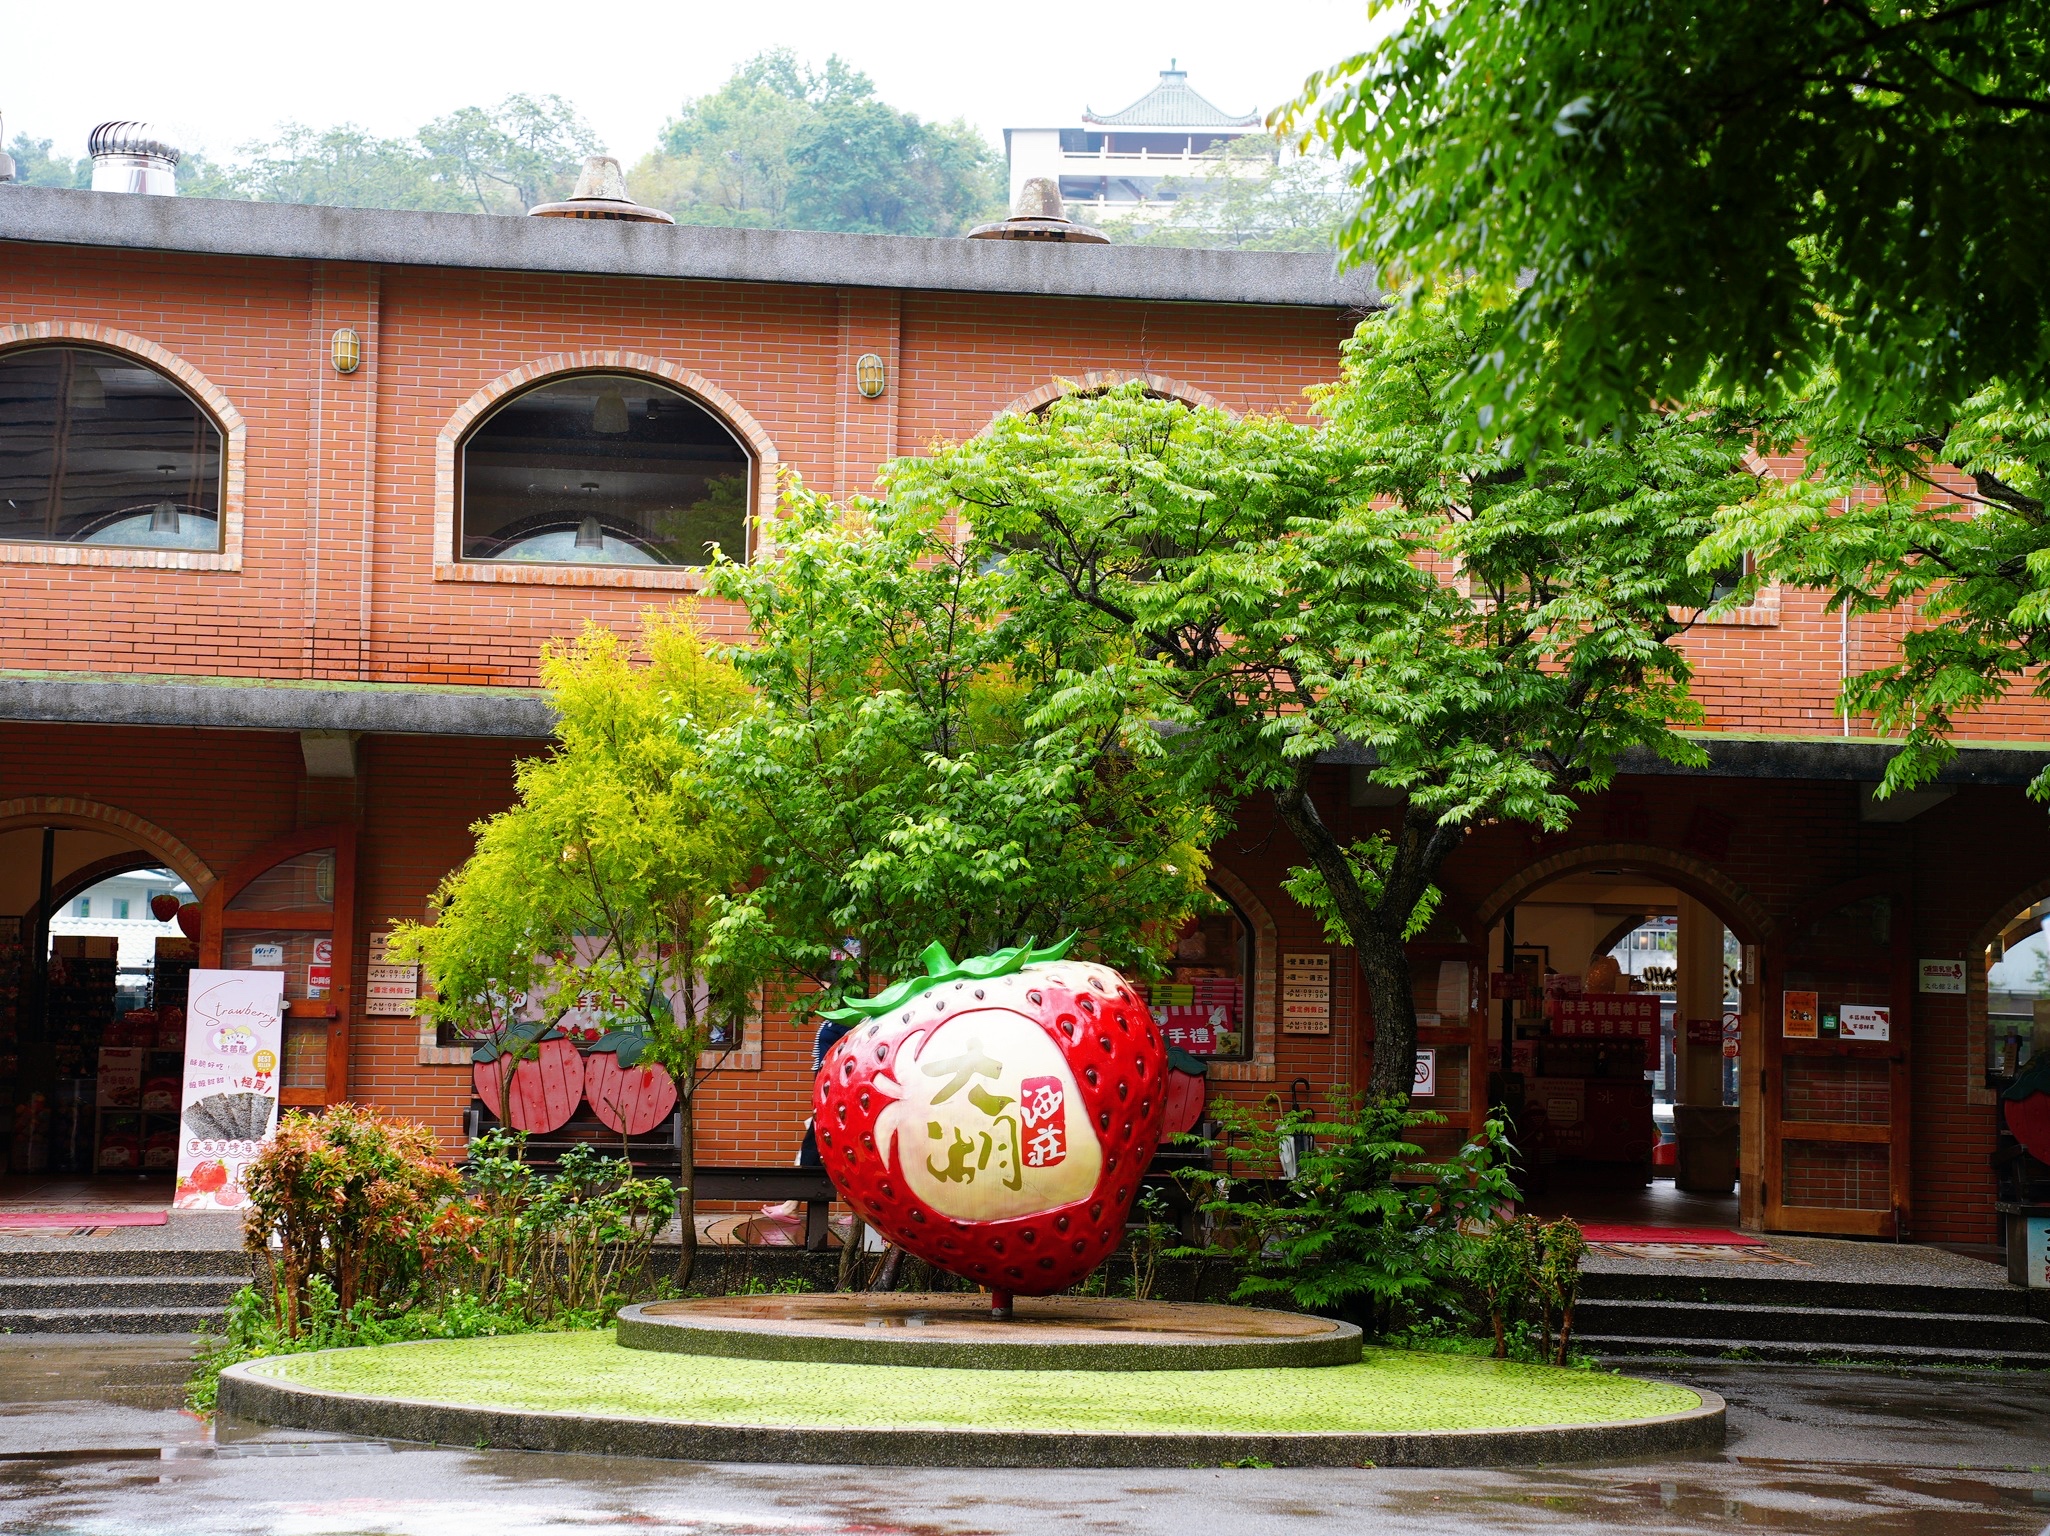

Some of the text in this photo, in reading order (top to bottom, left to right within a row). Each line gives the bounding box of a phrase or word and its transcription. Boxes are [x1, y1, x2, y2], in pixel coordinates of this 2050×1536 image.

[1290, 958, 1324, 966] 營業時間
[374, 986, 410, 994] 國定例假日
[194, 980, 278, 1028] Strawberry
[1562, 1001, 1653, 1017] 伴手禮結帳台
[1562, 1020, 1652, 1035] 請往泡芙區
[1160, 1027, 1211, 1044] 手禮
[257, 1055, 272, 1063] BEST
[241, 1076, 266, 1091] 極厚
[920, 1036, 1023, 1192] 大湖
[1020, 1085, 1067, 1166] 酒莊
